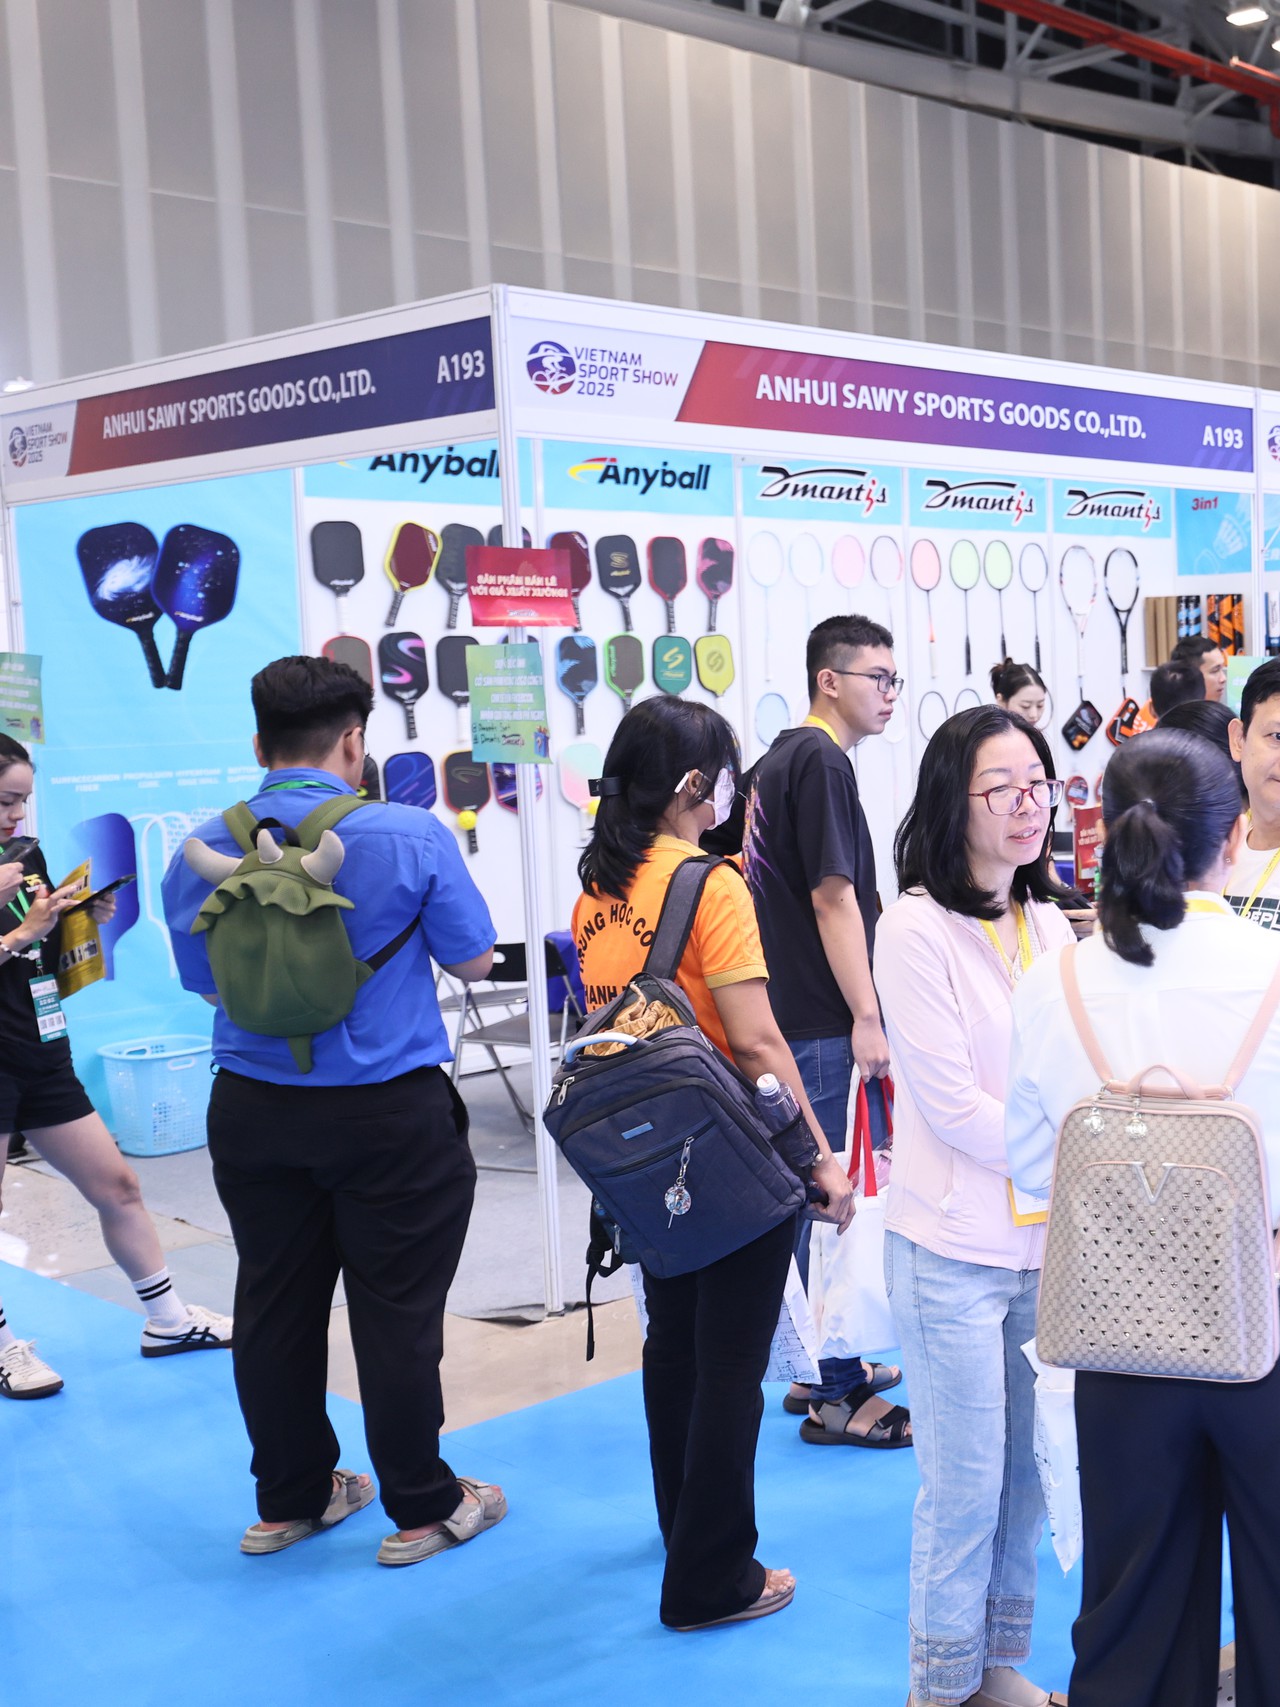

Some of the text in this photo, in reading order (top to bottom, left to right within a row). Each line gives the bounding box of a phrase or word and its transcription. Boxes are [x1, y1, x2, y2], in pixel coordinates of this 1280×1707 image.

[437, 350, 485, 383] A193
[574, 346, 642, 366] VIETNAM
[578, 363, 679, 386] SPORT SHOW
[577, 380, 615, 397] 2025
[103, 409, 145, 440] ANHUI
[147, 402, 187, 431] SAWY
[189, 390, 245, 424] SPORTS
[248, 380, 305, 413] GOODS
[755, 374, 1147, 439] ANHUI SAWY SPORTS GOODS CO.,LTD.
[1202, 425, 1244, 449] A193
[598, 459, 711, 495] Anyball
[1191, 496, 1219, 511] 3in1
